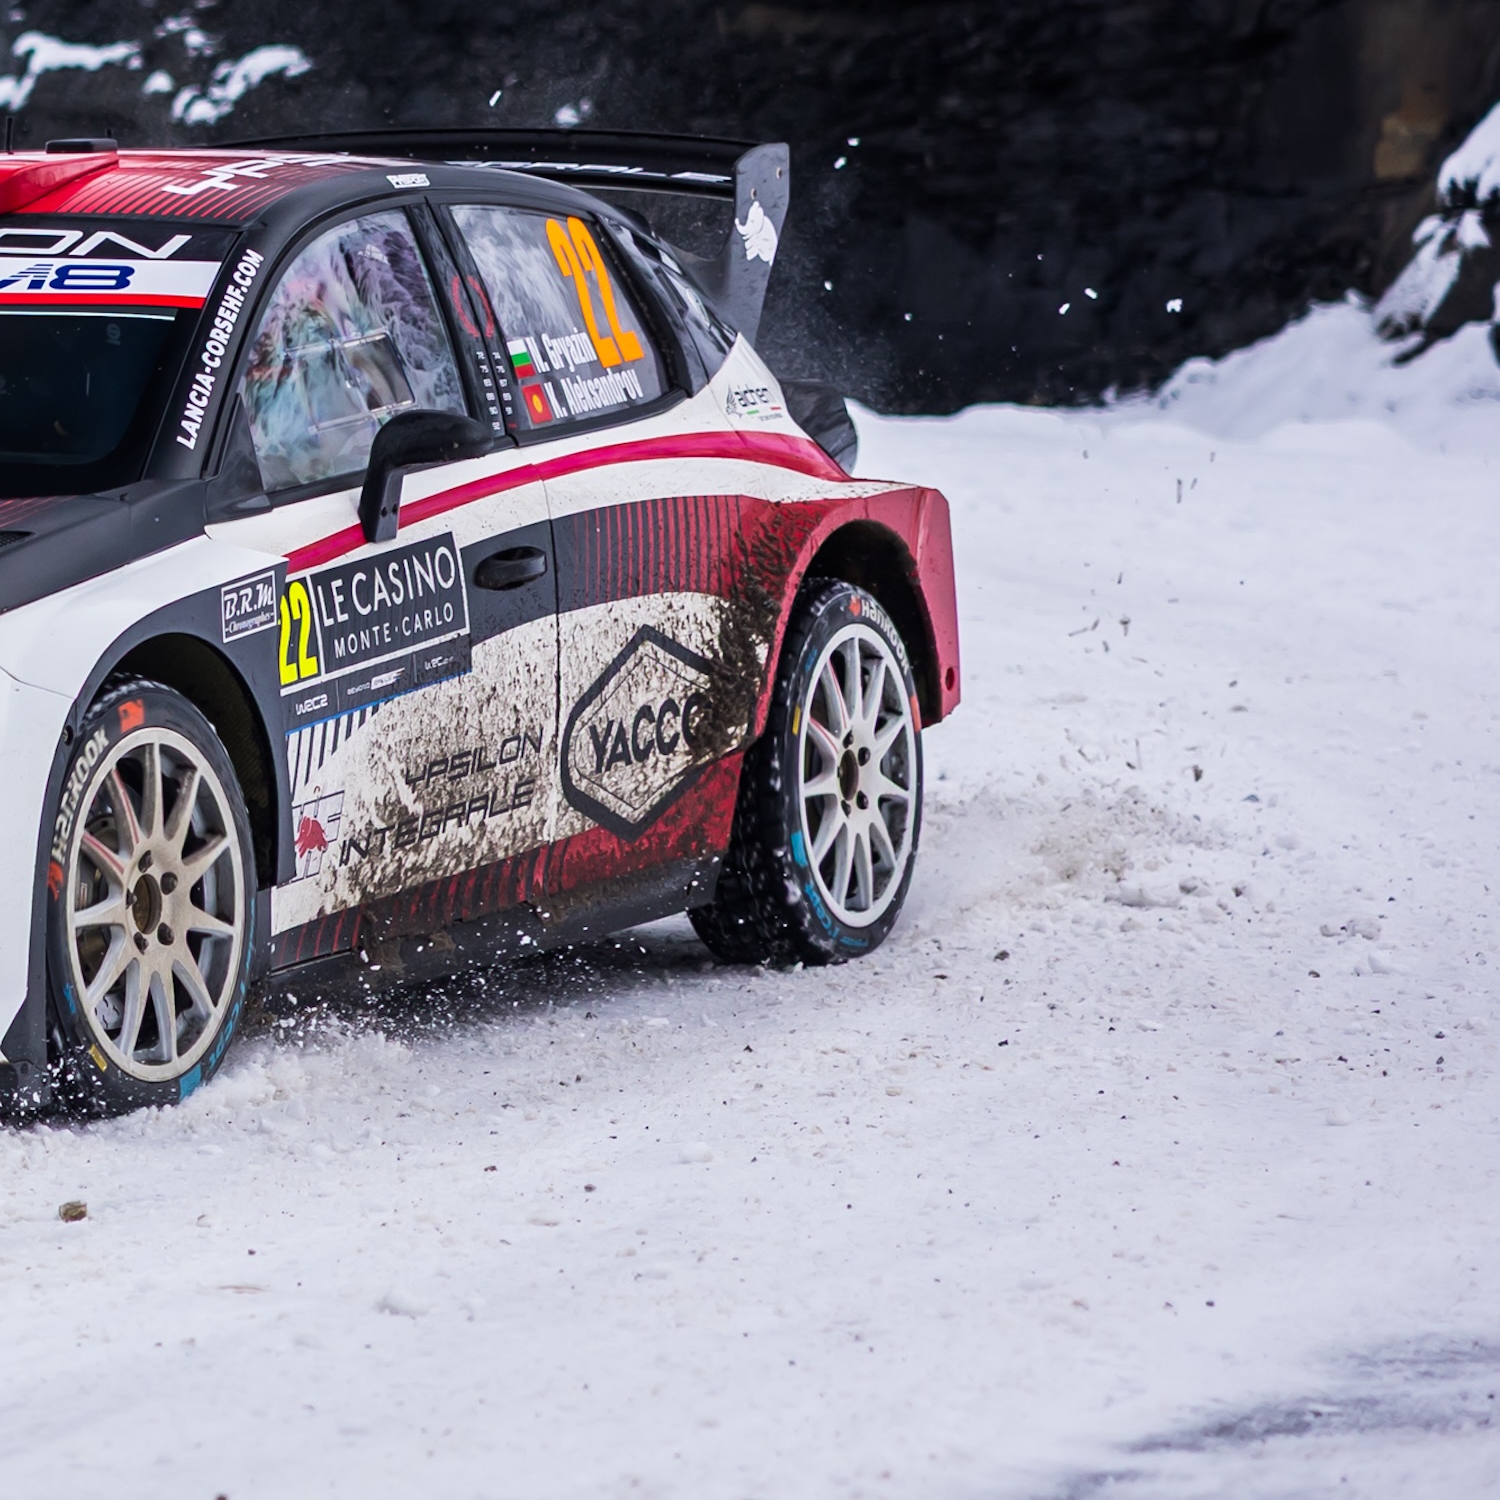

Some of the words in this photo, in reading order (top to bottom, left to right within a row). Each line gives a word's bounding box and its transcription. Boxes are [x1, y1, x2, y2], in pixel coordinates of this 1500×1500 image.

[545, 215, 645, 369] 22
[176, 249, 264, 451] LANCIA-CORSEHF.COM
[525, 336, 549, 374] N.
[543, 382, 568, 419] K.
[560, 367, 644, 416] Aleksandrov
[317, 578, 349, 628] LE
[351, 545, 457, 617] CASINO
[278, 580, 319, 686] 22
[406, 726, 543, 793] YPSILON
